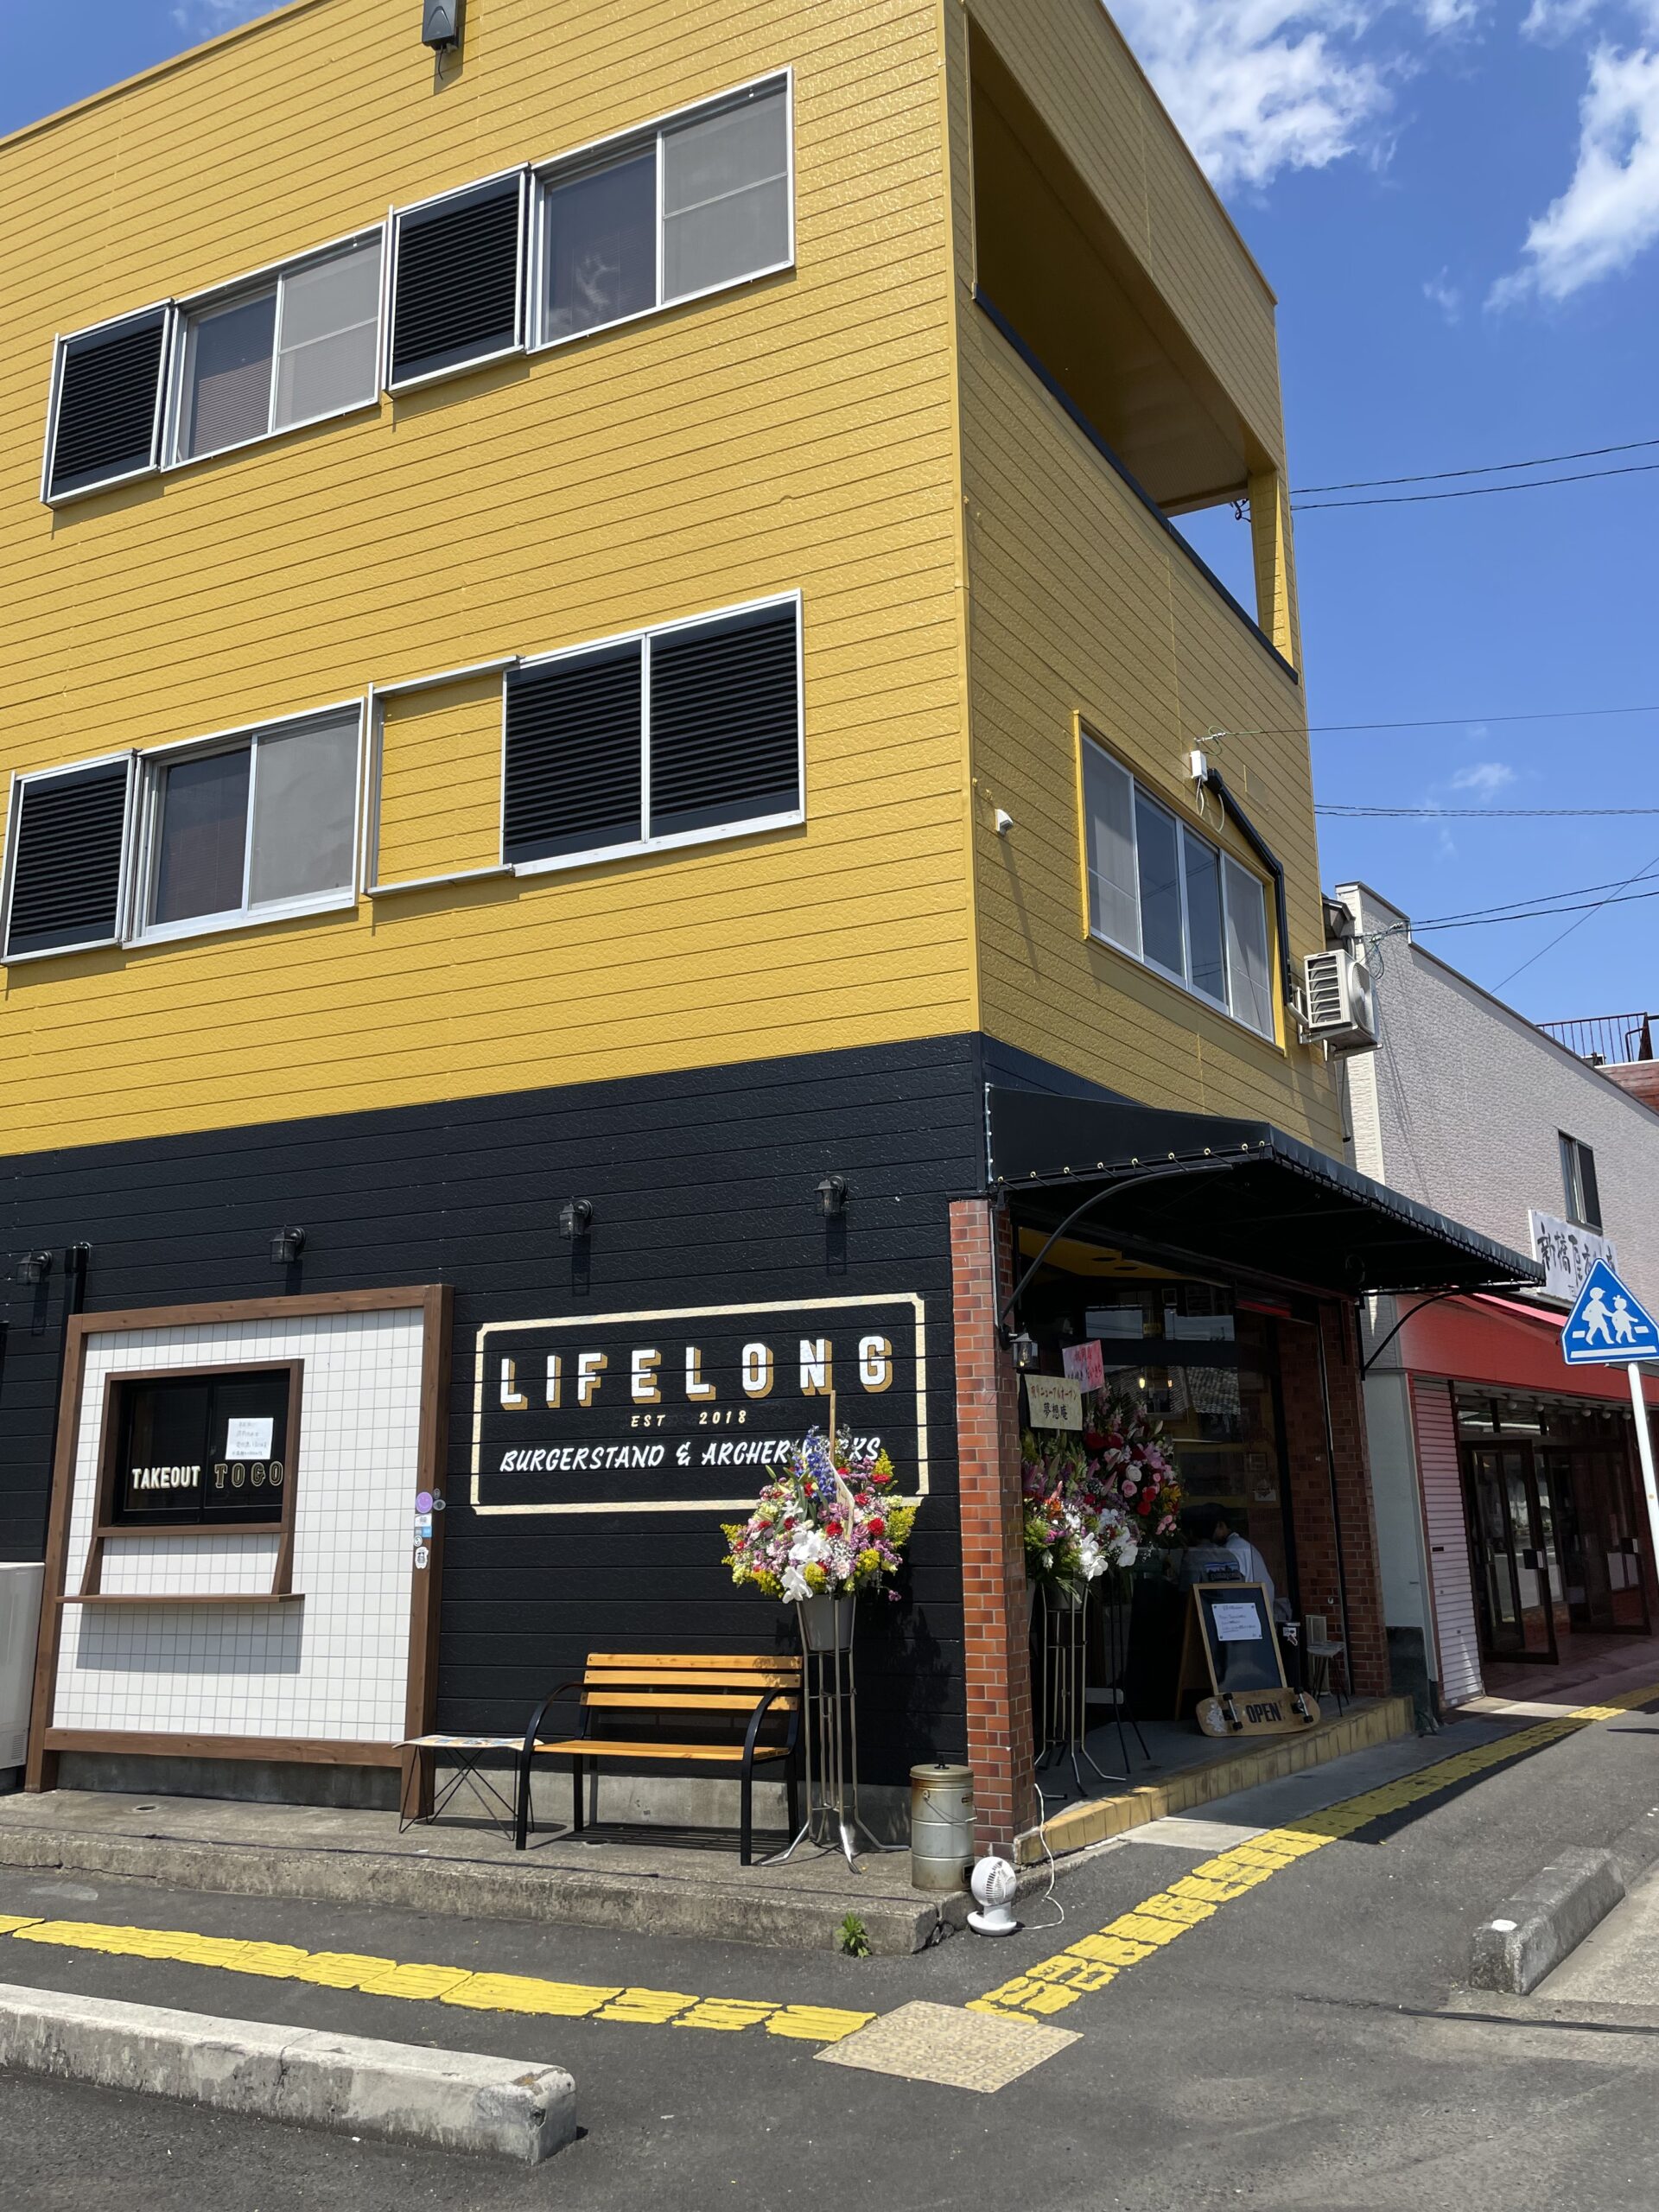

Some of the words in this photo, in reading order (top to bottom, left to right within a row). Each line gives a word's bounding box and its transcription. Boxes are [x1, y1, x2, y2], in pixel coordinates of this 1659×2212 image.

[500, 1335, 892, 1410] LIFELONG
[631, 1414, 666, 1427] EST
[699, 1411, 747, 1425] 2018
[499, 1445, 664, 1472] BURGERSTAND
[676, 1441, 691, 1466] &
[802, 1437, 880, 1463] WKS
[131, 1465, 200, 1489] TAKEOUT
